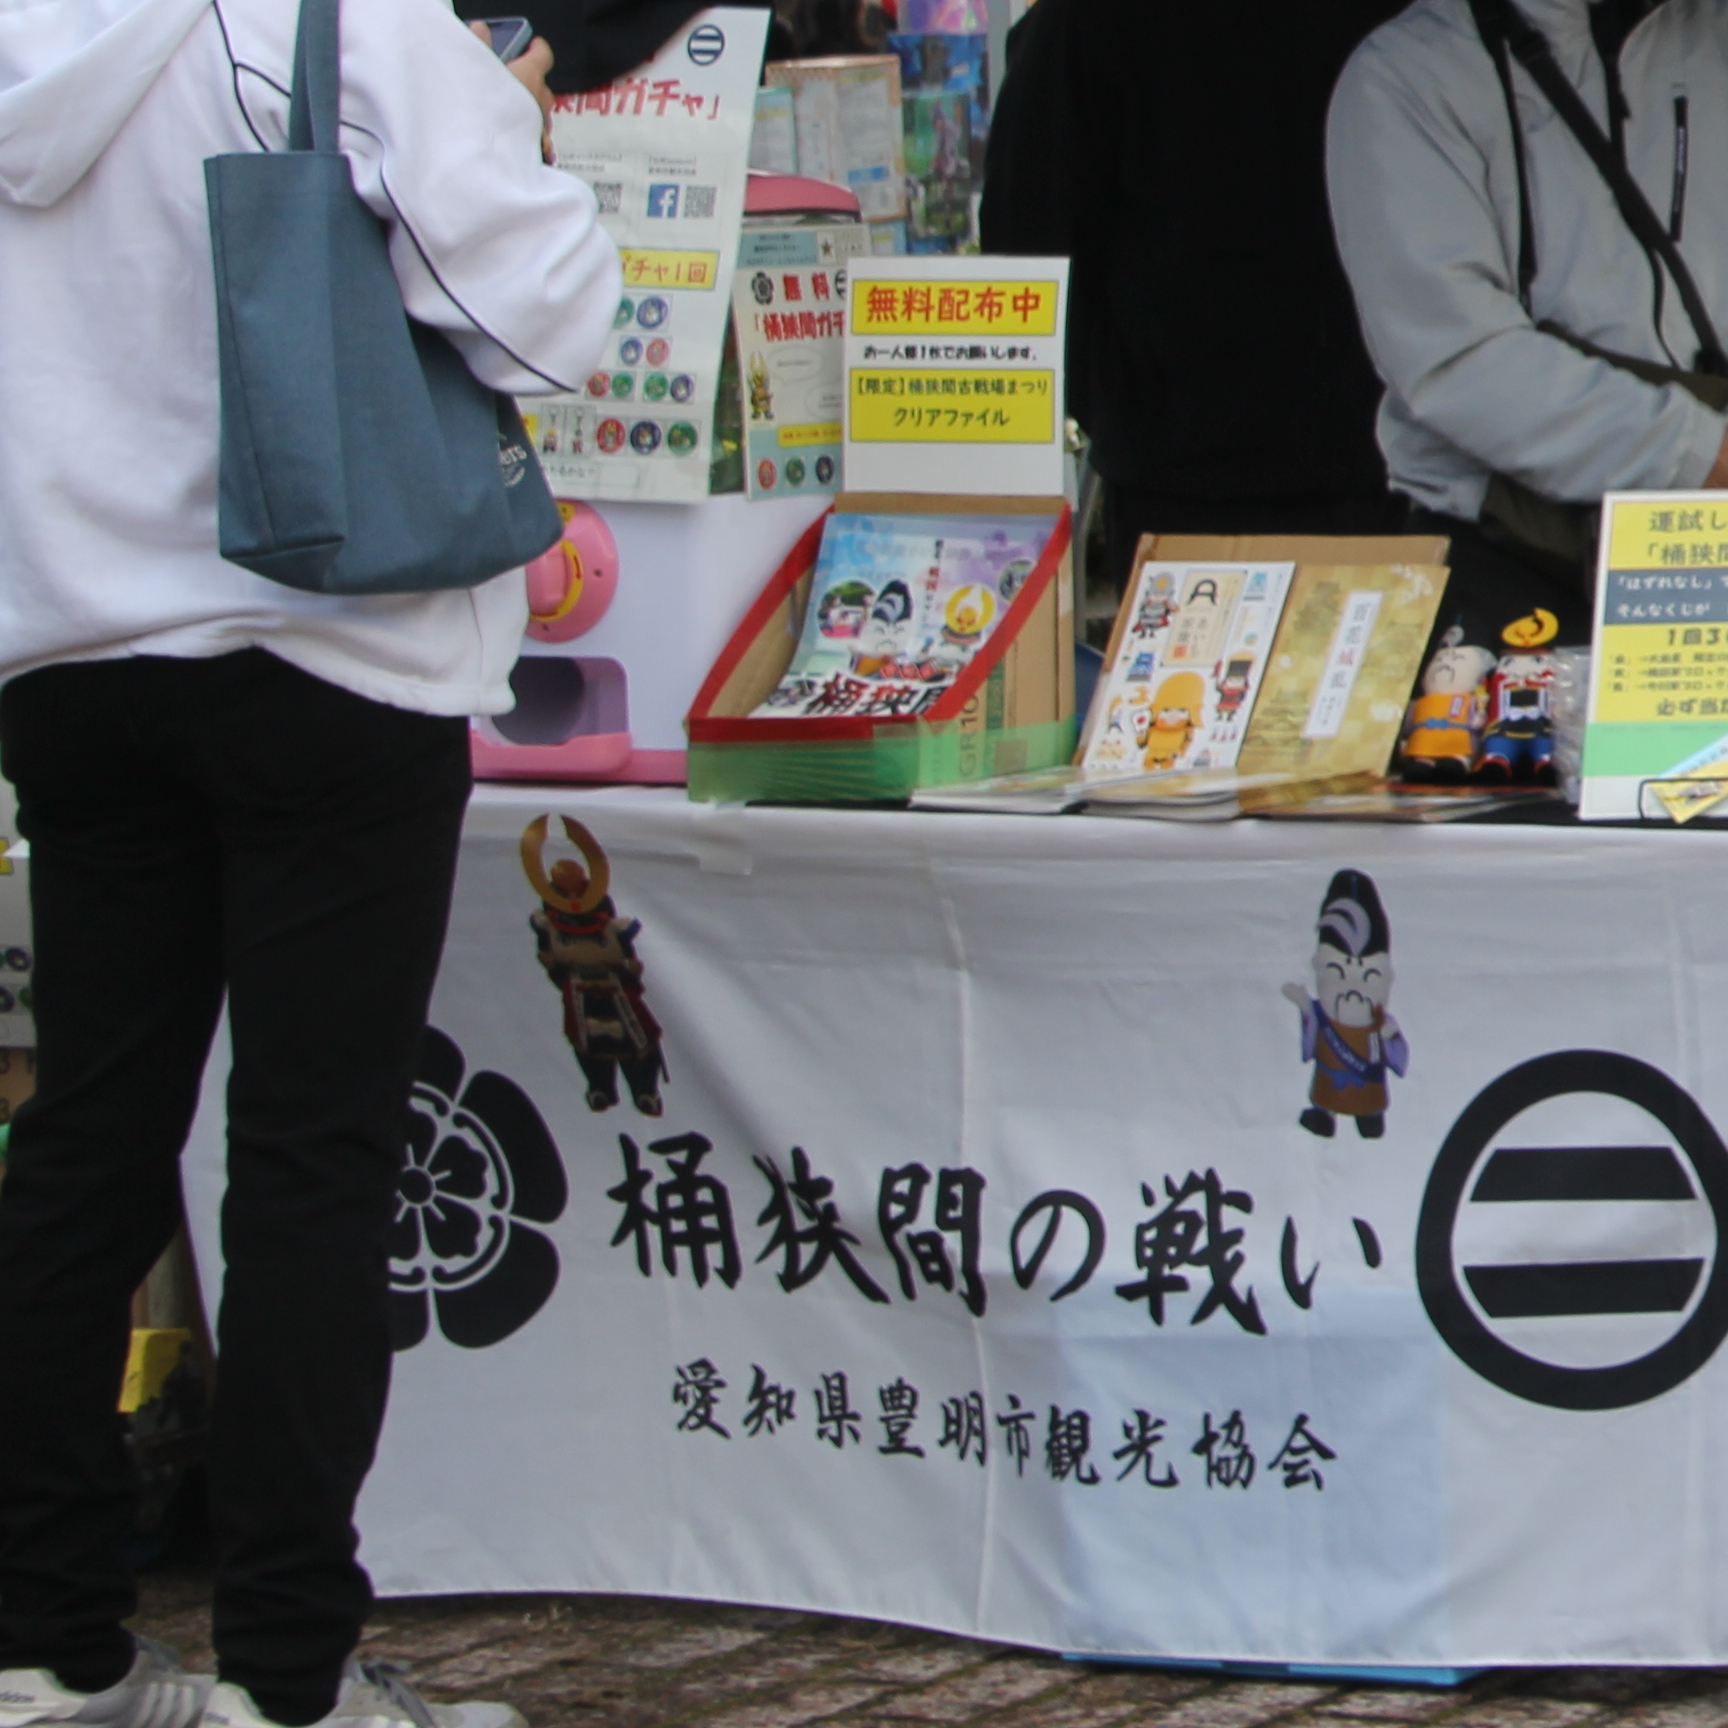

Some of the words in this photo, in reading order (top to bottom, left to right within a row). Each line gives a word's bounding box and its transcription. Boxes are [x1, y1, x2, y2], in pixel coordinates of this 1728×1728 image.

[867, 285, 1041, 323] 無料配布中
[894, 407, 1011, 428] クリアファイル
[607, 1132, 1382, 1335] 桶狭間の戦い
[672, 1358, 1338, 1490] 愛知県豊明市観光協会
